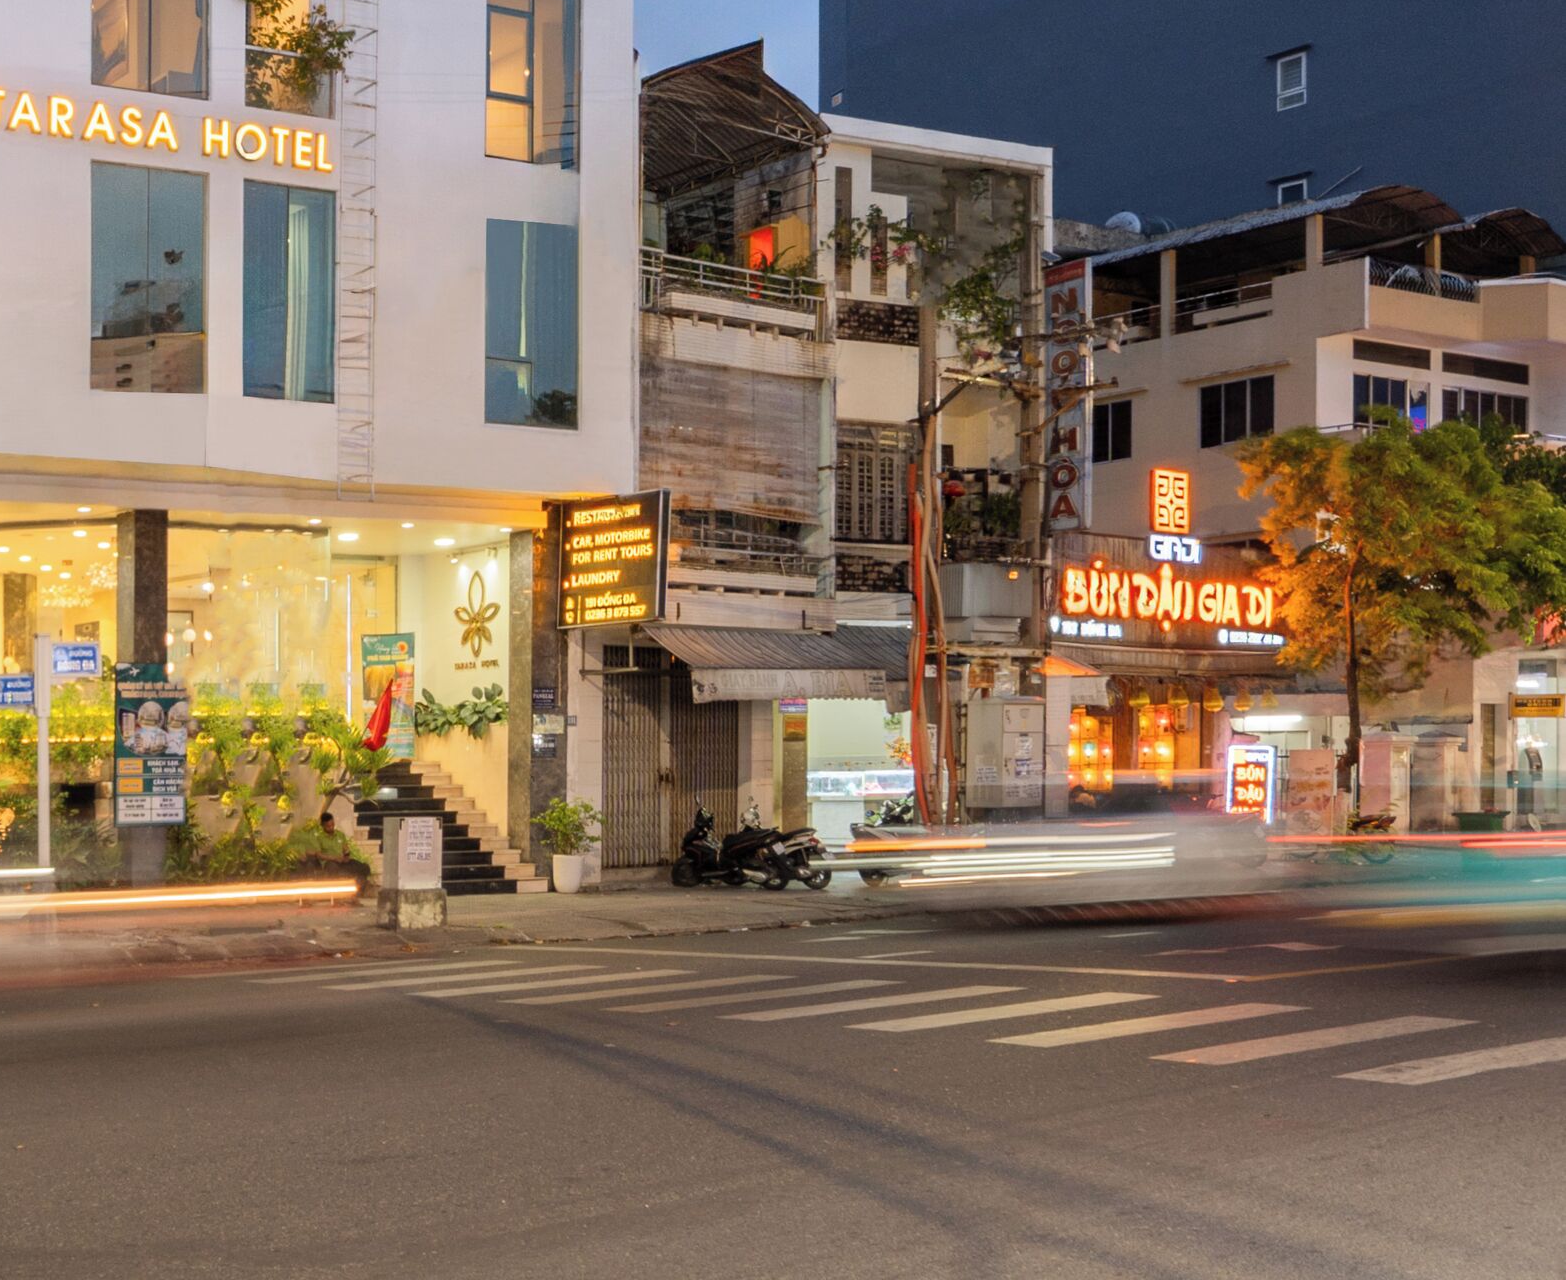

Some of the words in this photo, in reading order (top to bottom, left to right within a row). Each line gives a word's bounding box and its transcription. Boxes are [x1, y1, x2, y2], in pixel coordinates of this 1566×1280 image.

[201, 117, 334, 174] HOTEL
[595, 527, 651, 546] MOTORBIKE
[572, 552, 591, 565] FOR
[594, 547, 618, 562] RENT
[620, 544, 653, 559] TOURS
[571, 570, 621, 587] LAUNDRY
[1199, 582, 1241, 627] GIA
